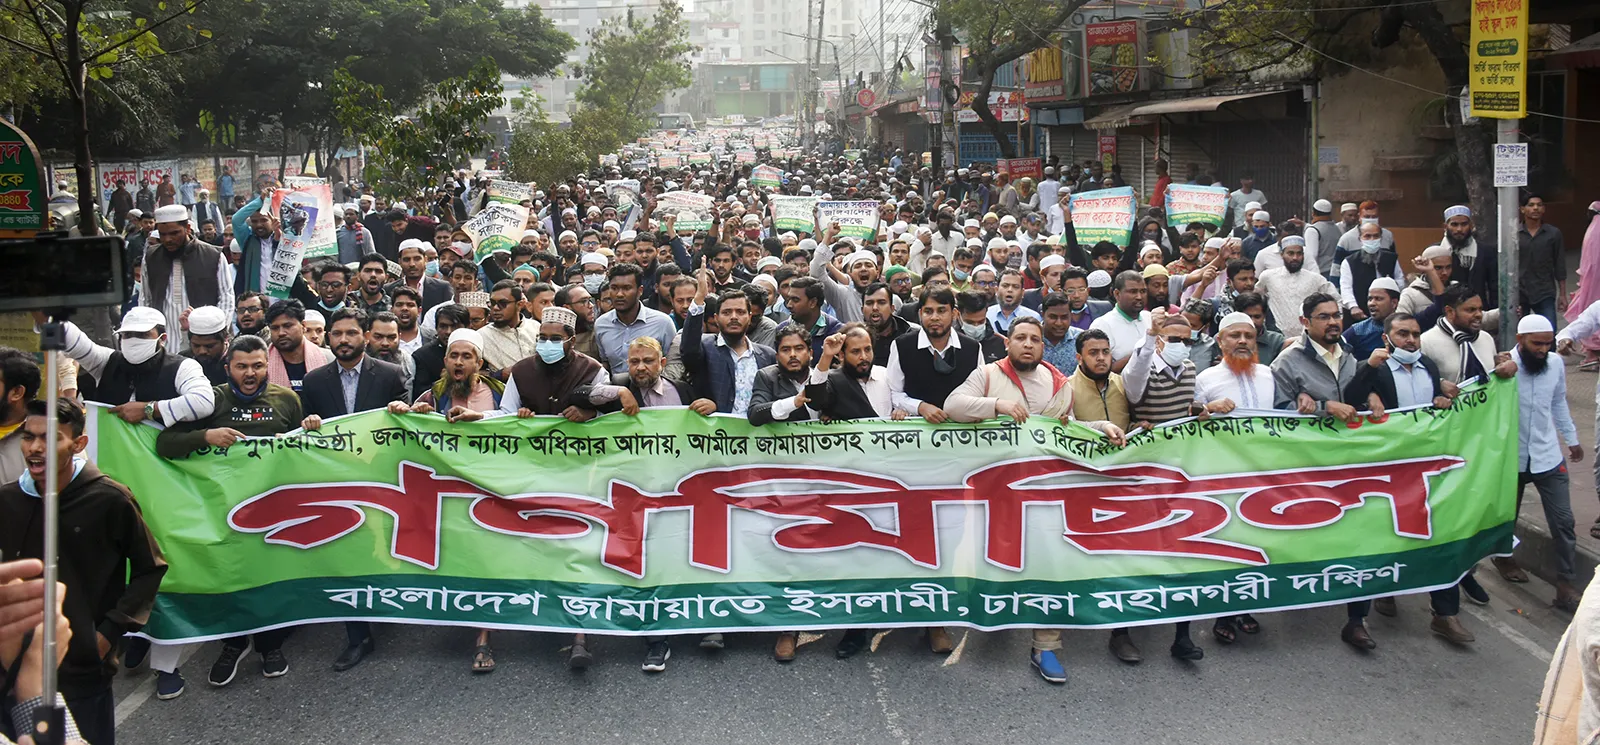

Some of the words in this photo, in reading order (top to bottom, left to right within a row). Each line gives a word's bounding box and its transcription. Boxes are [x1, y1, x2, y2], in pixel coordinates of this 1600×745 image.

[370, 427, 461, 452] জনগণের
[467, 432, 521, 454] ন্যায্য
[527, 429, 607, 456] অধিকার
[614, 432, 681, 458] আদায়,
[687, 429, 749, 456] আমীরে
[755, 431, 865, 455] জামায়াতসহ
[868, 429, 923, 450] সকল
[931, 421, 1021, 448] নেতাকর্মী
[1030, 428, 1046, 445] ও
[228, 455, 1466, 577] গণমিছিল
[323, 585, 547, 616] বাংলাদেশ
[558, 593, 772, 621] জামায়াতে
[782, 582, 968, 617] ইসলামী,
[979, 592, 1080, 617] ঢাকা
[1091, 572, 1277, 612] মহানগরী
[1287, 562, 1407, 593] দক্ষিণ
